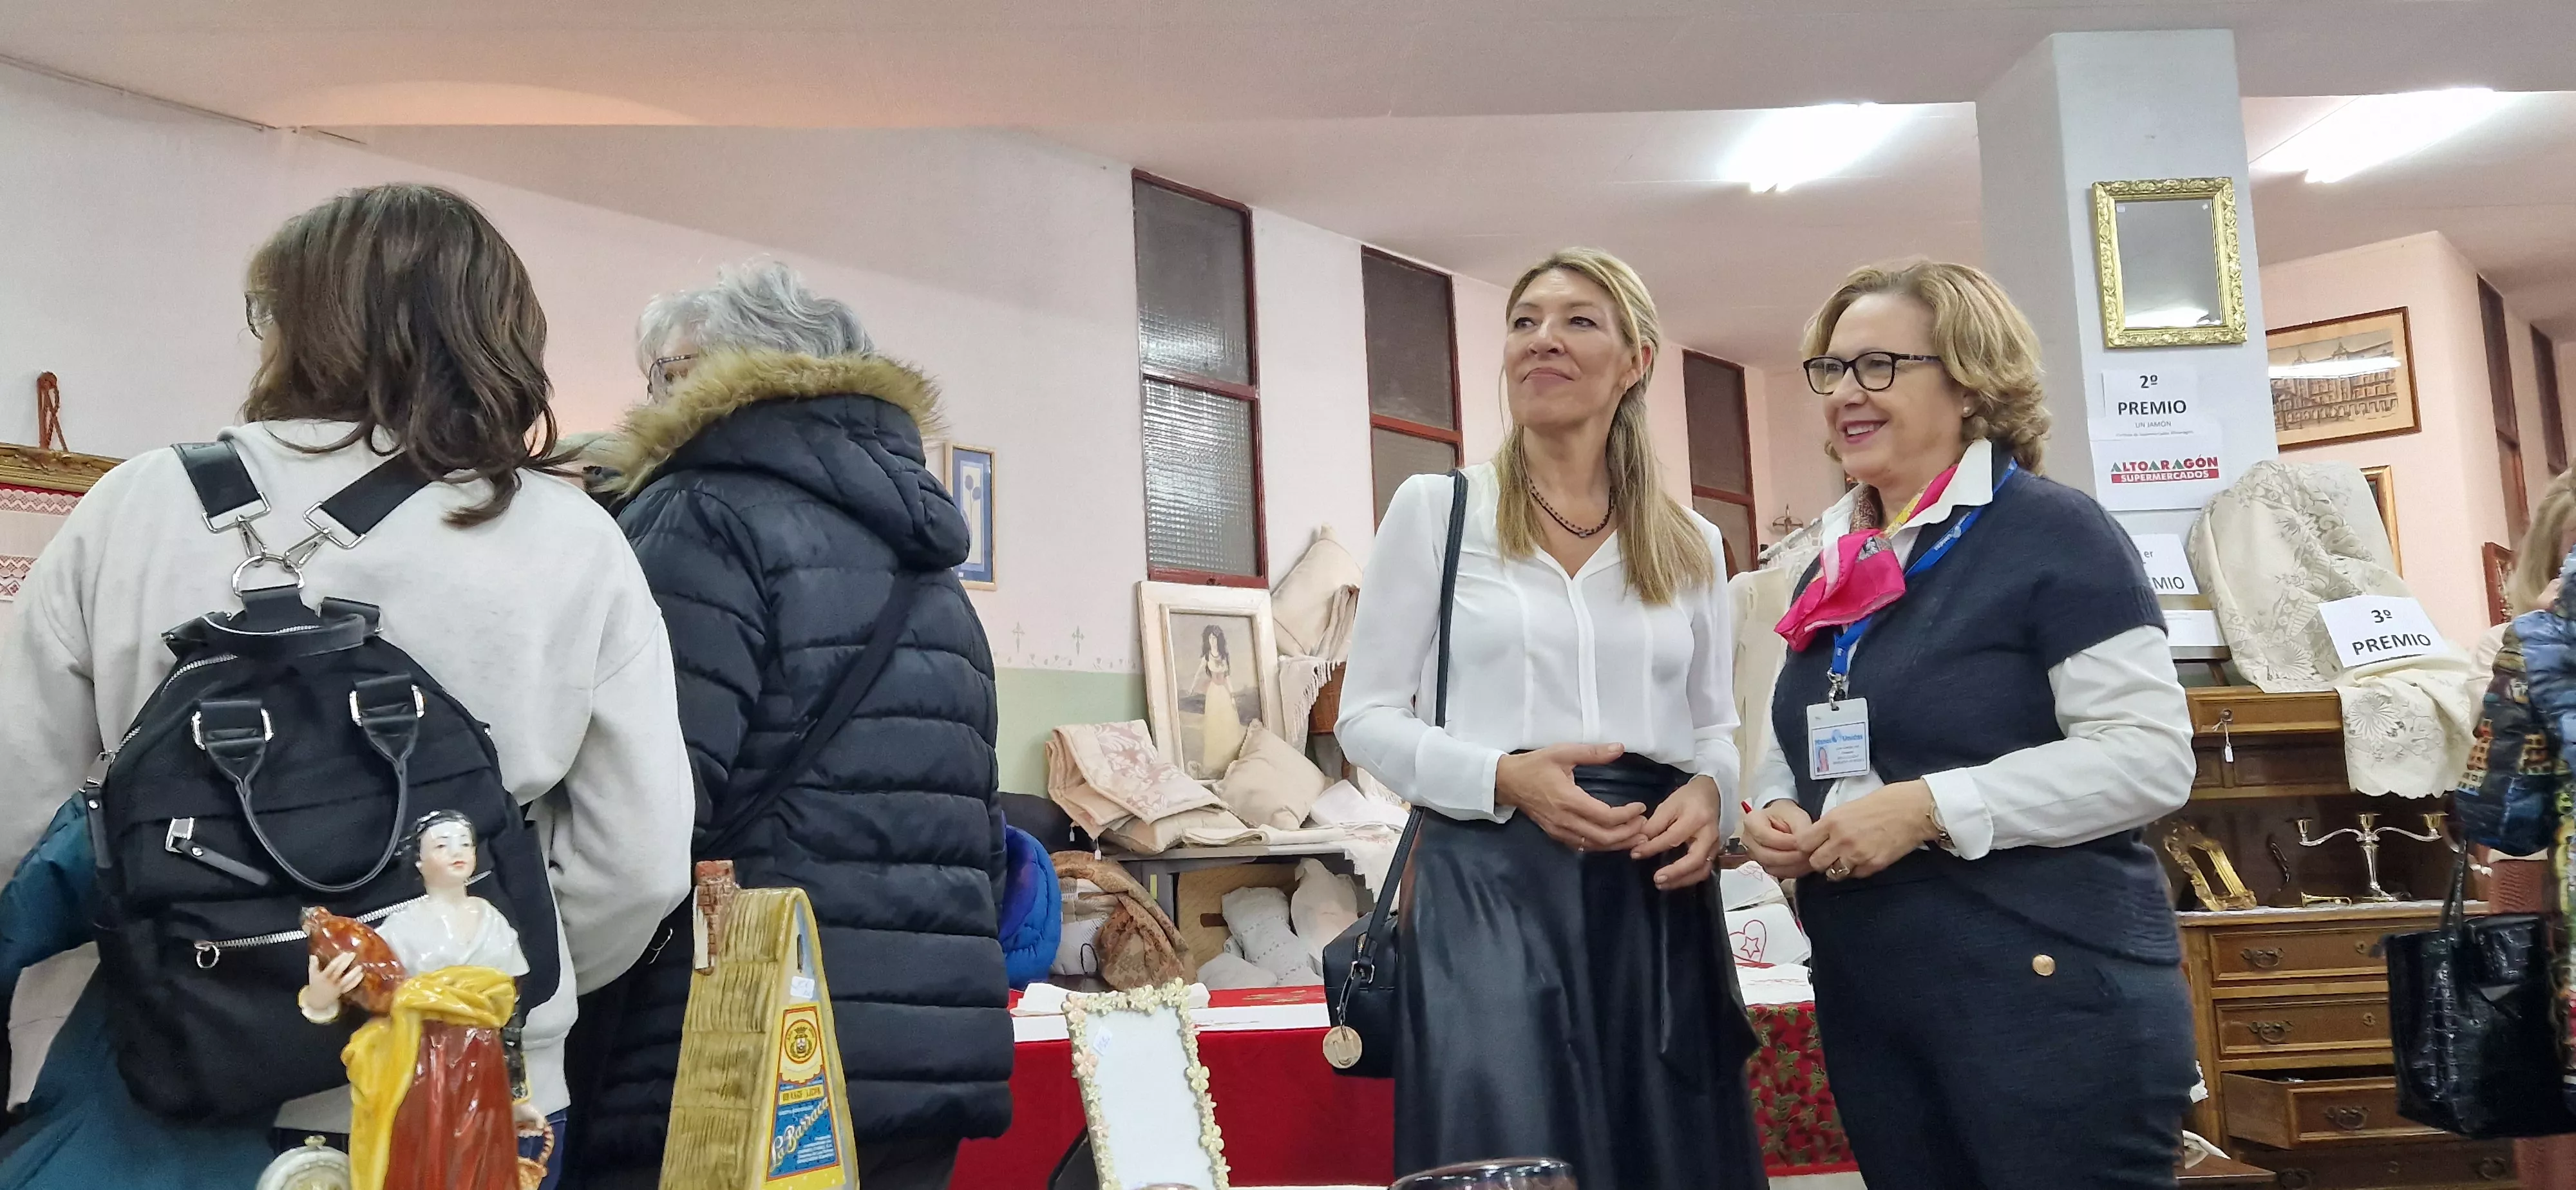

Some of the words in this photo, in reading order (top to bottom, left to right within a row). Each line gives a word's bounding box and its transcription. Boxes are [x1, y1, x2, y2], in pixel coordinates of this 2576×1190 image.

[2139, 374, 2158, 389] 2º
[2117, 399, 2187, 416] PREMIO
[2110, 453, 2218, 472] ALTOARAGÓN
[2121, 470, 2209, 482] SUPERMERCADOS
[2371, 609, 2393, 623] 3º
[2352, 634, 2431, 656] PREMIO
